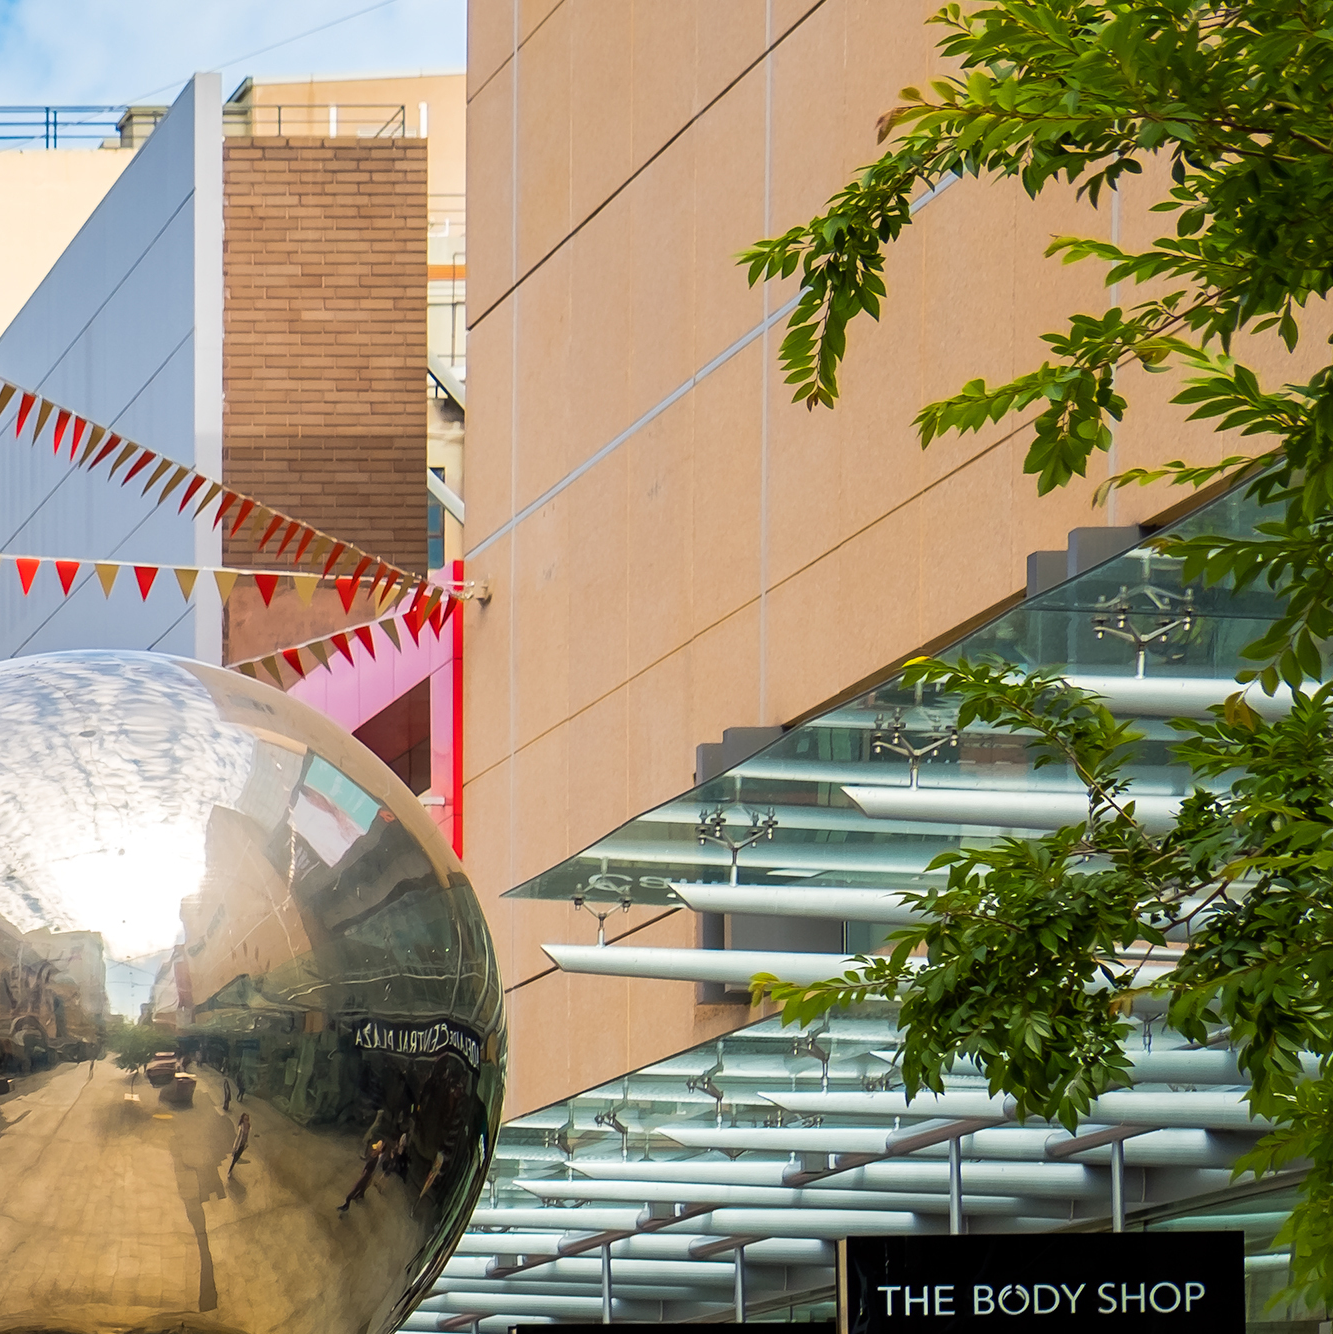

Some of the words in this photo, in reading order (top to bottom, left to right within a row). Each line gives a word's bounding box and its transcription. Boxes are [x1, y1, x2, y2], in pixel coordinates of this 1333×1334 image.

[877, 1285, 956, 1316] THE
[973, 1283, 1086, 1316] BODY
[1097, 1282, 1206, 1315] SHOP
